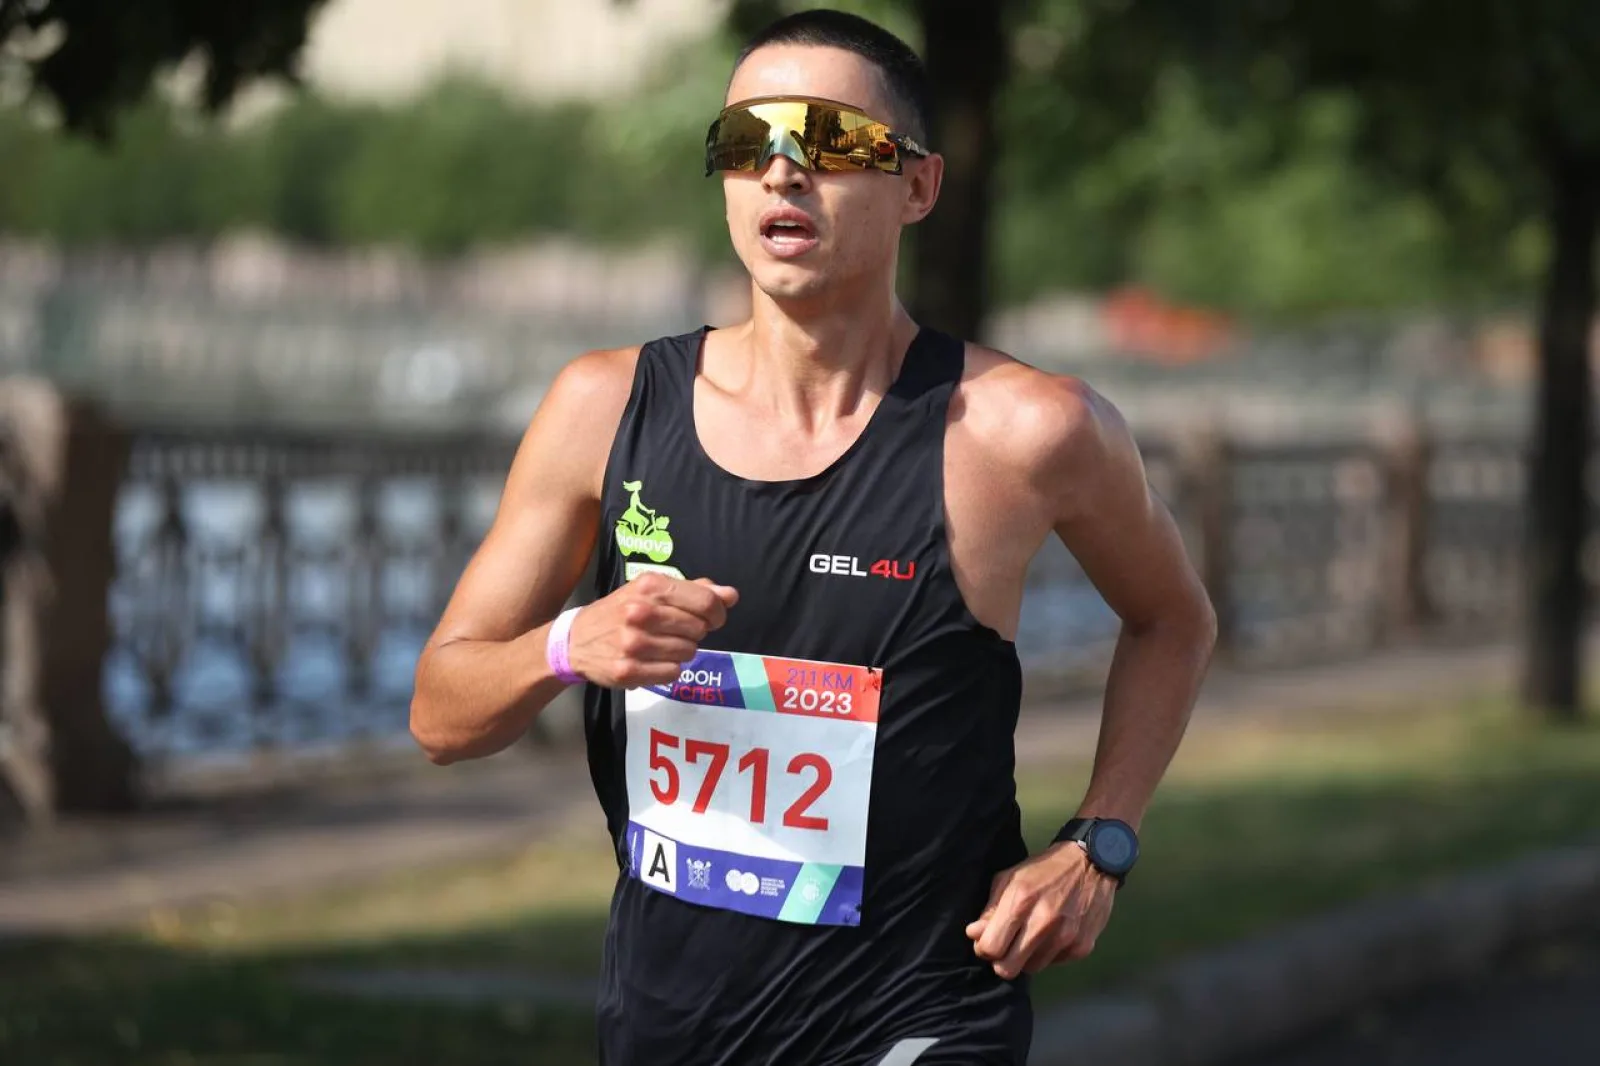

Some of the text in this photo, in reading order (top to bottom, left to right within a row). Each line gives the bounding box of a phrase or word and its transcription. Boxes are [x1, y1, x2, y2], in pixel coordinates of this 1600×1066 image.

[679, 669, 722, 687] ФОН
[783, 686, 852, 715] 2023
[649, 727, 832, 831] 5712
